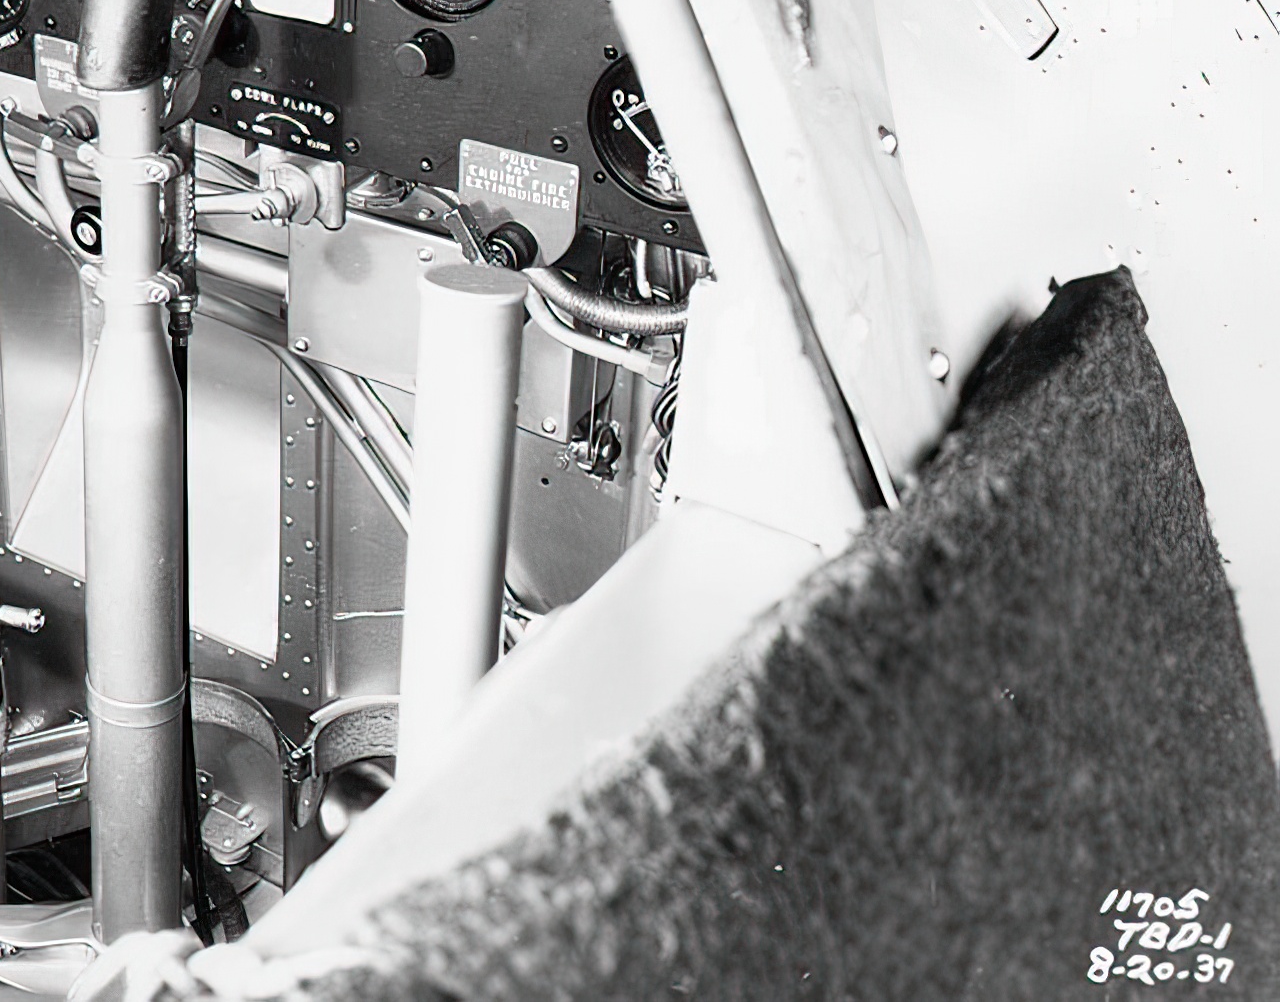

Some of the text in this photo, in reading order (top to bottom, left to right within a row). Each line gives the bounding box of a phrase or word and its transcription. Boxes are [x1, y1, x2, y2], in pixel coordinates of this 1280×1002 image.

[244, 86, 324, 117] COWL FLAPS
[499, 151, 539, 171] PULL
[467, 163, 568, 199] ENGINE FIRE
